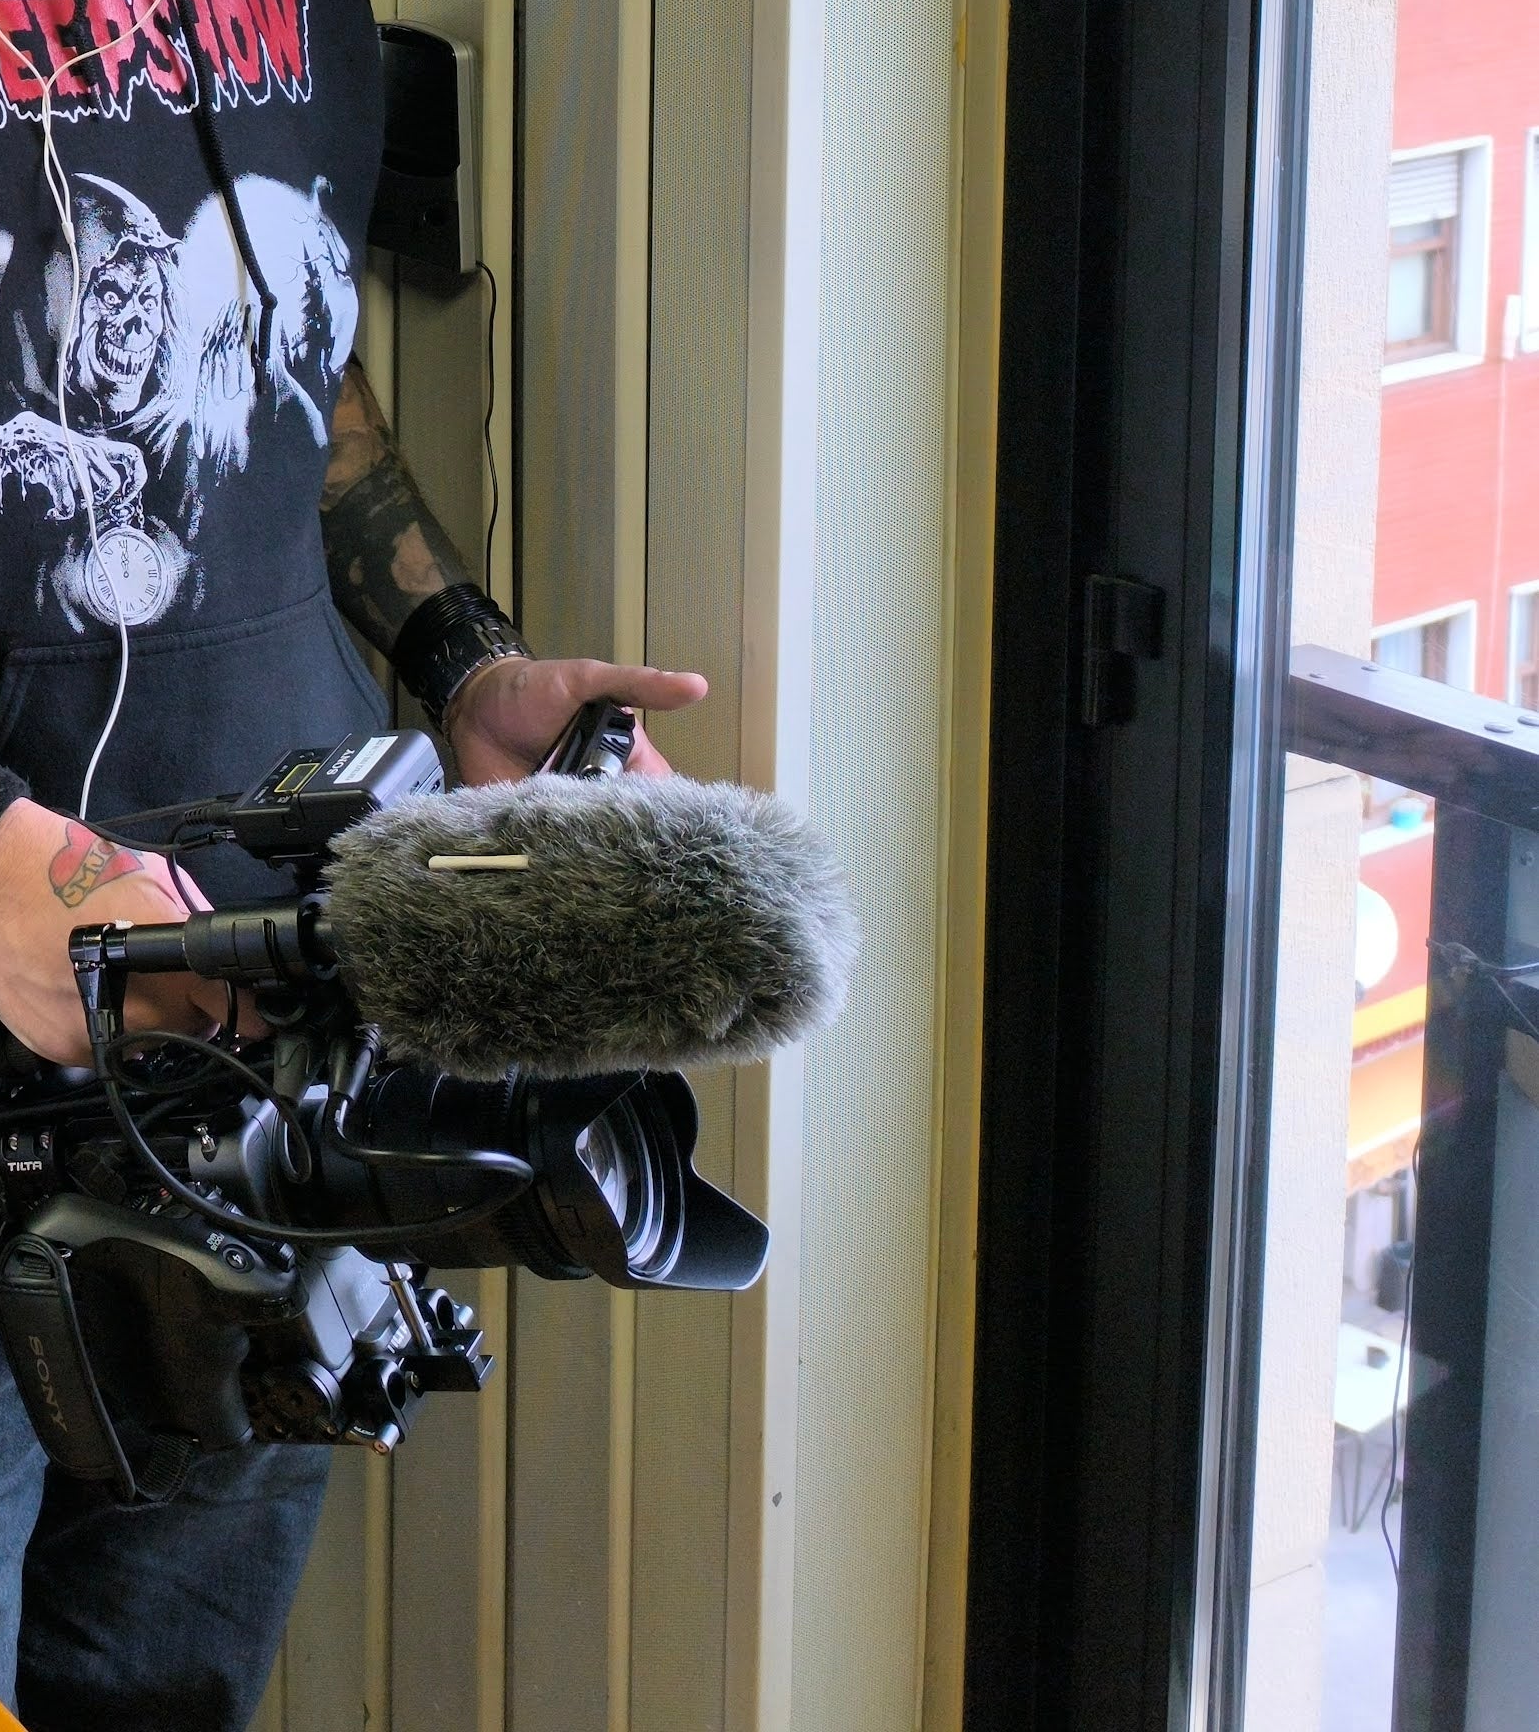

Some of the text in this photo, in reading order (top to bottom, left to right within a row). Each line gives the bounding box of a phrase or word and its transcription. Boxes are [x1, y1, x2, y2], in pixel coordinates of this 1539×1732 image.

[326, 748, 355, 776] SONY
[7, 1161, 43, 1172] TILTA
[28, 1335, 68, 1432] SONY
